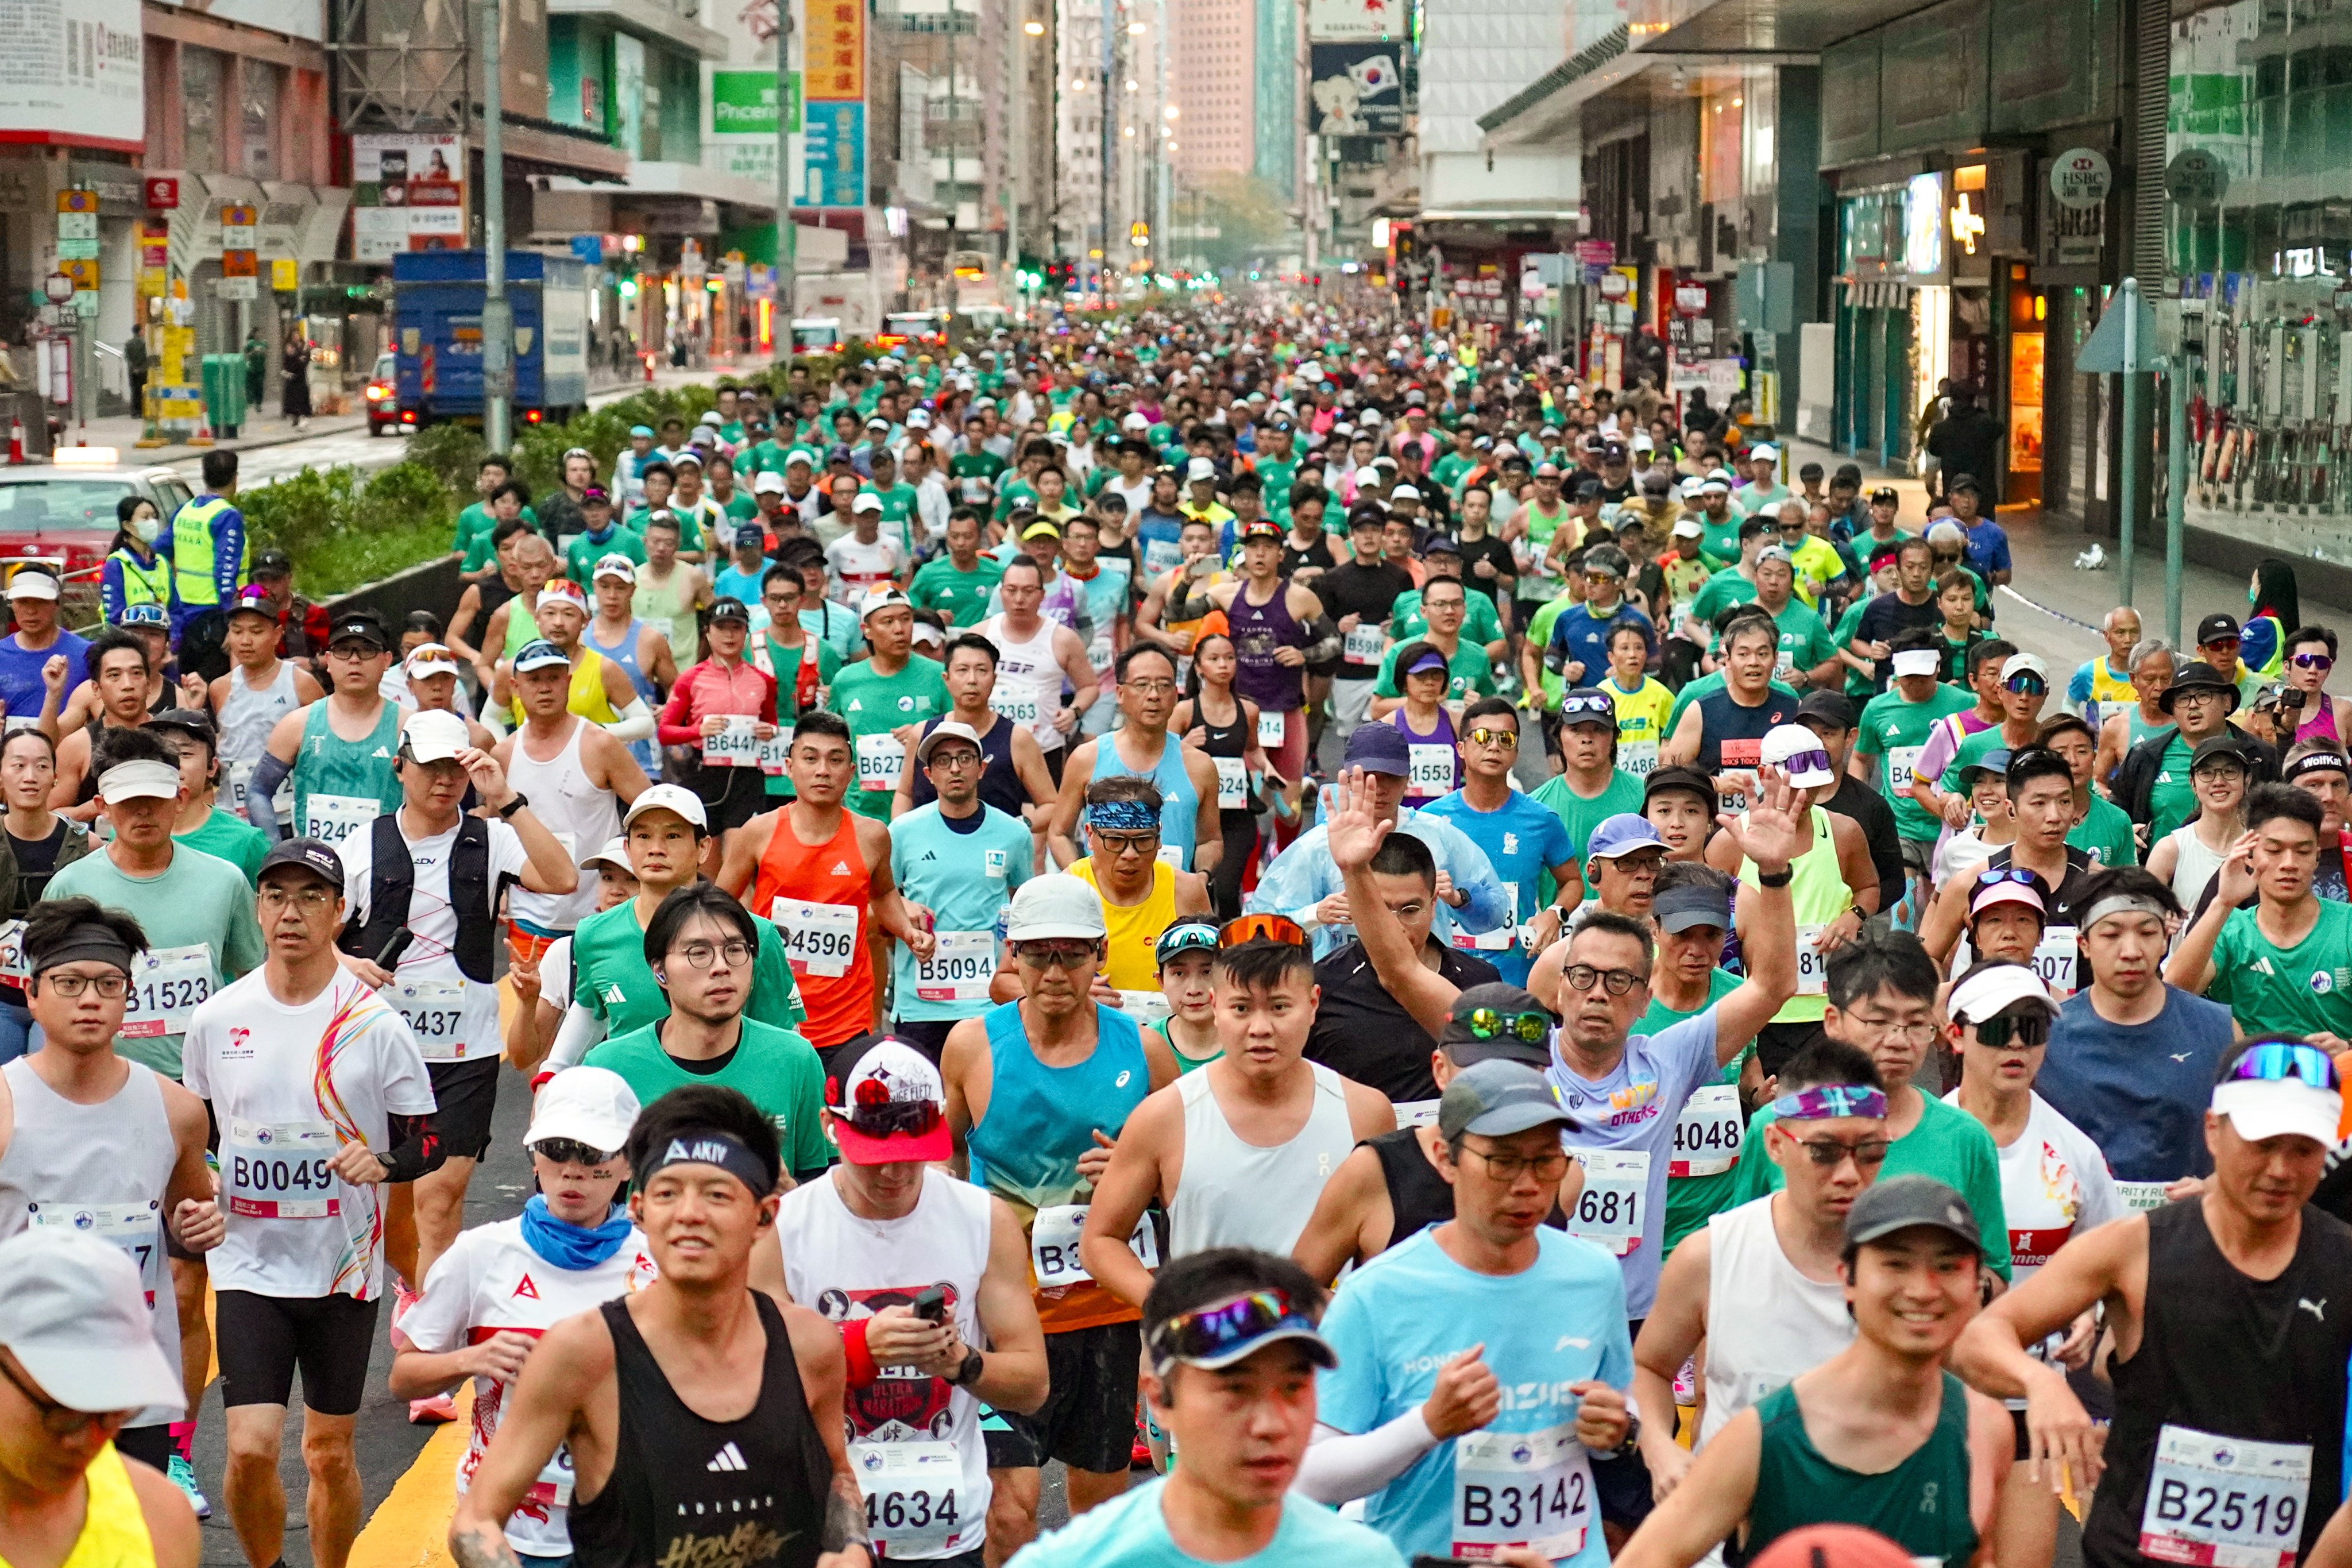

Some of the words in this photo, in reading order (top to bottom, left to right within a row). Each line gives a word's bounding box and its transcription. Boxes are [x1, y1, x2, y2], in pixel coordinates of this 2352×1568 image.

[2064, 172, 2103, 185] HSBC
[989, 704, 1034, 723] 2363
[706, 736, 757, 752] B6447
[2303, 755, 2342, 768] WolfKat
[921, 957, 992, 980] B5094
[1611, 1106, 1658, 1127] OTHERS
[233, 1156, 332, 1192] B0049
[2117, 1187, 2149, 1198] RITY
[1462, 1472, 1586, 1528] B3142
[2157, 1478, 2297, 1538] B2519
